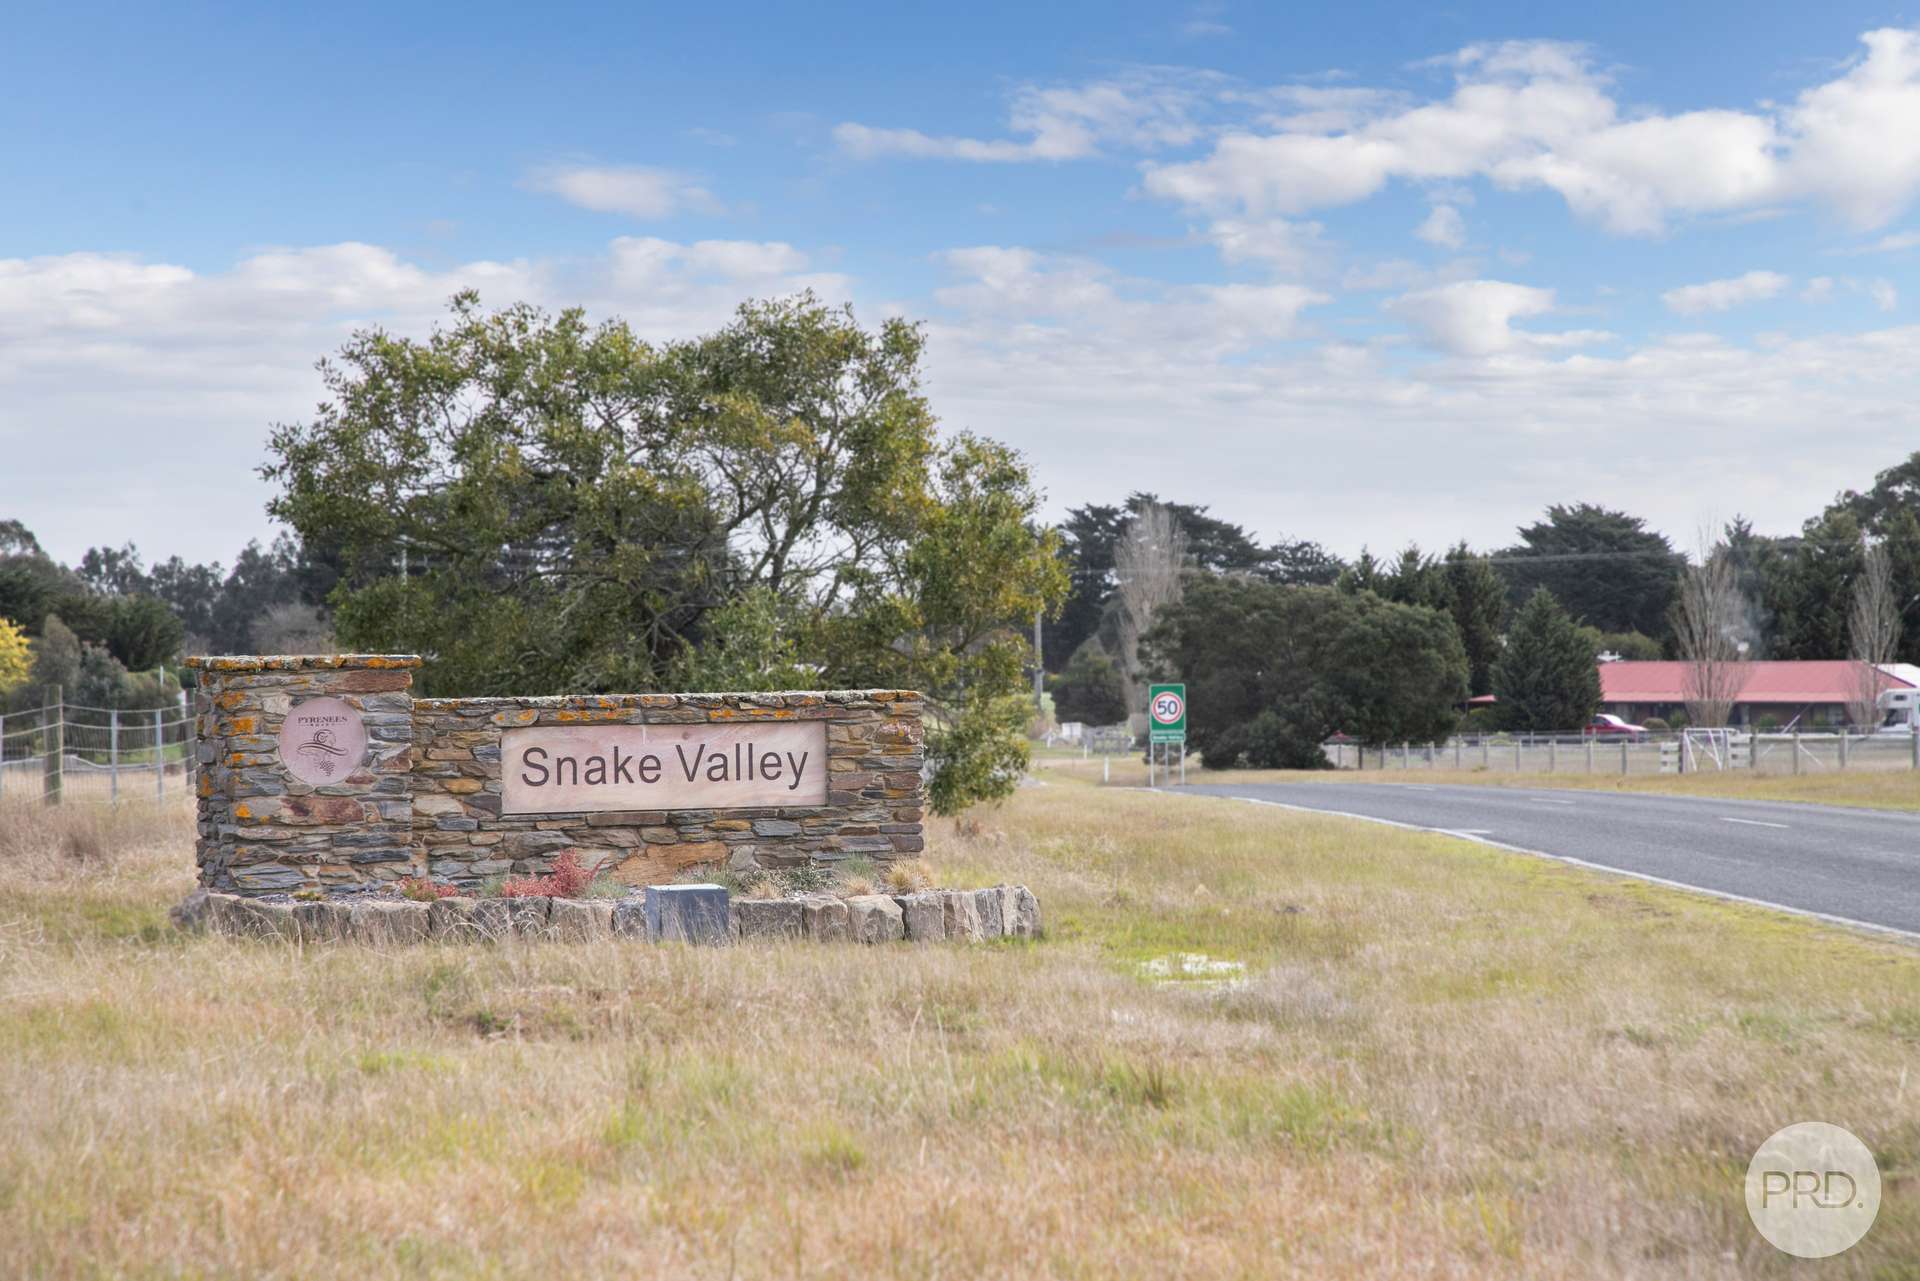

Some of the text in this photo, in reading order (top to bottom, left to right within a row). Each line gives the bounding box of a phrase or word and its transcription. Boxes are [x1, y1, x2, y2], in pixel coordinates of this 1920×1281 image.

[1157, 700, 1178, 715] 50
[297, 716, 348, 724] PYRENEES
[521, 742, 808, 790] Snake Valley
